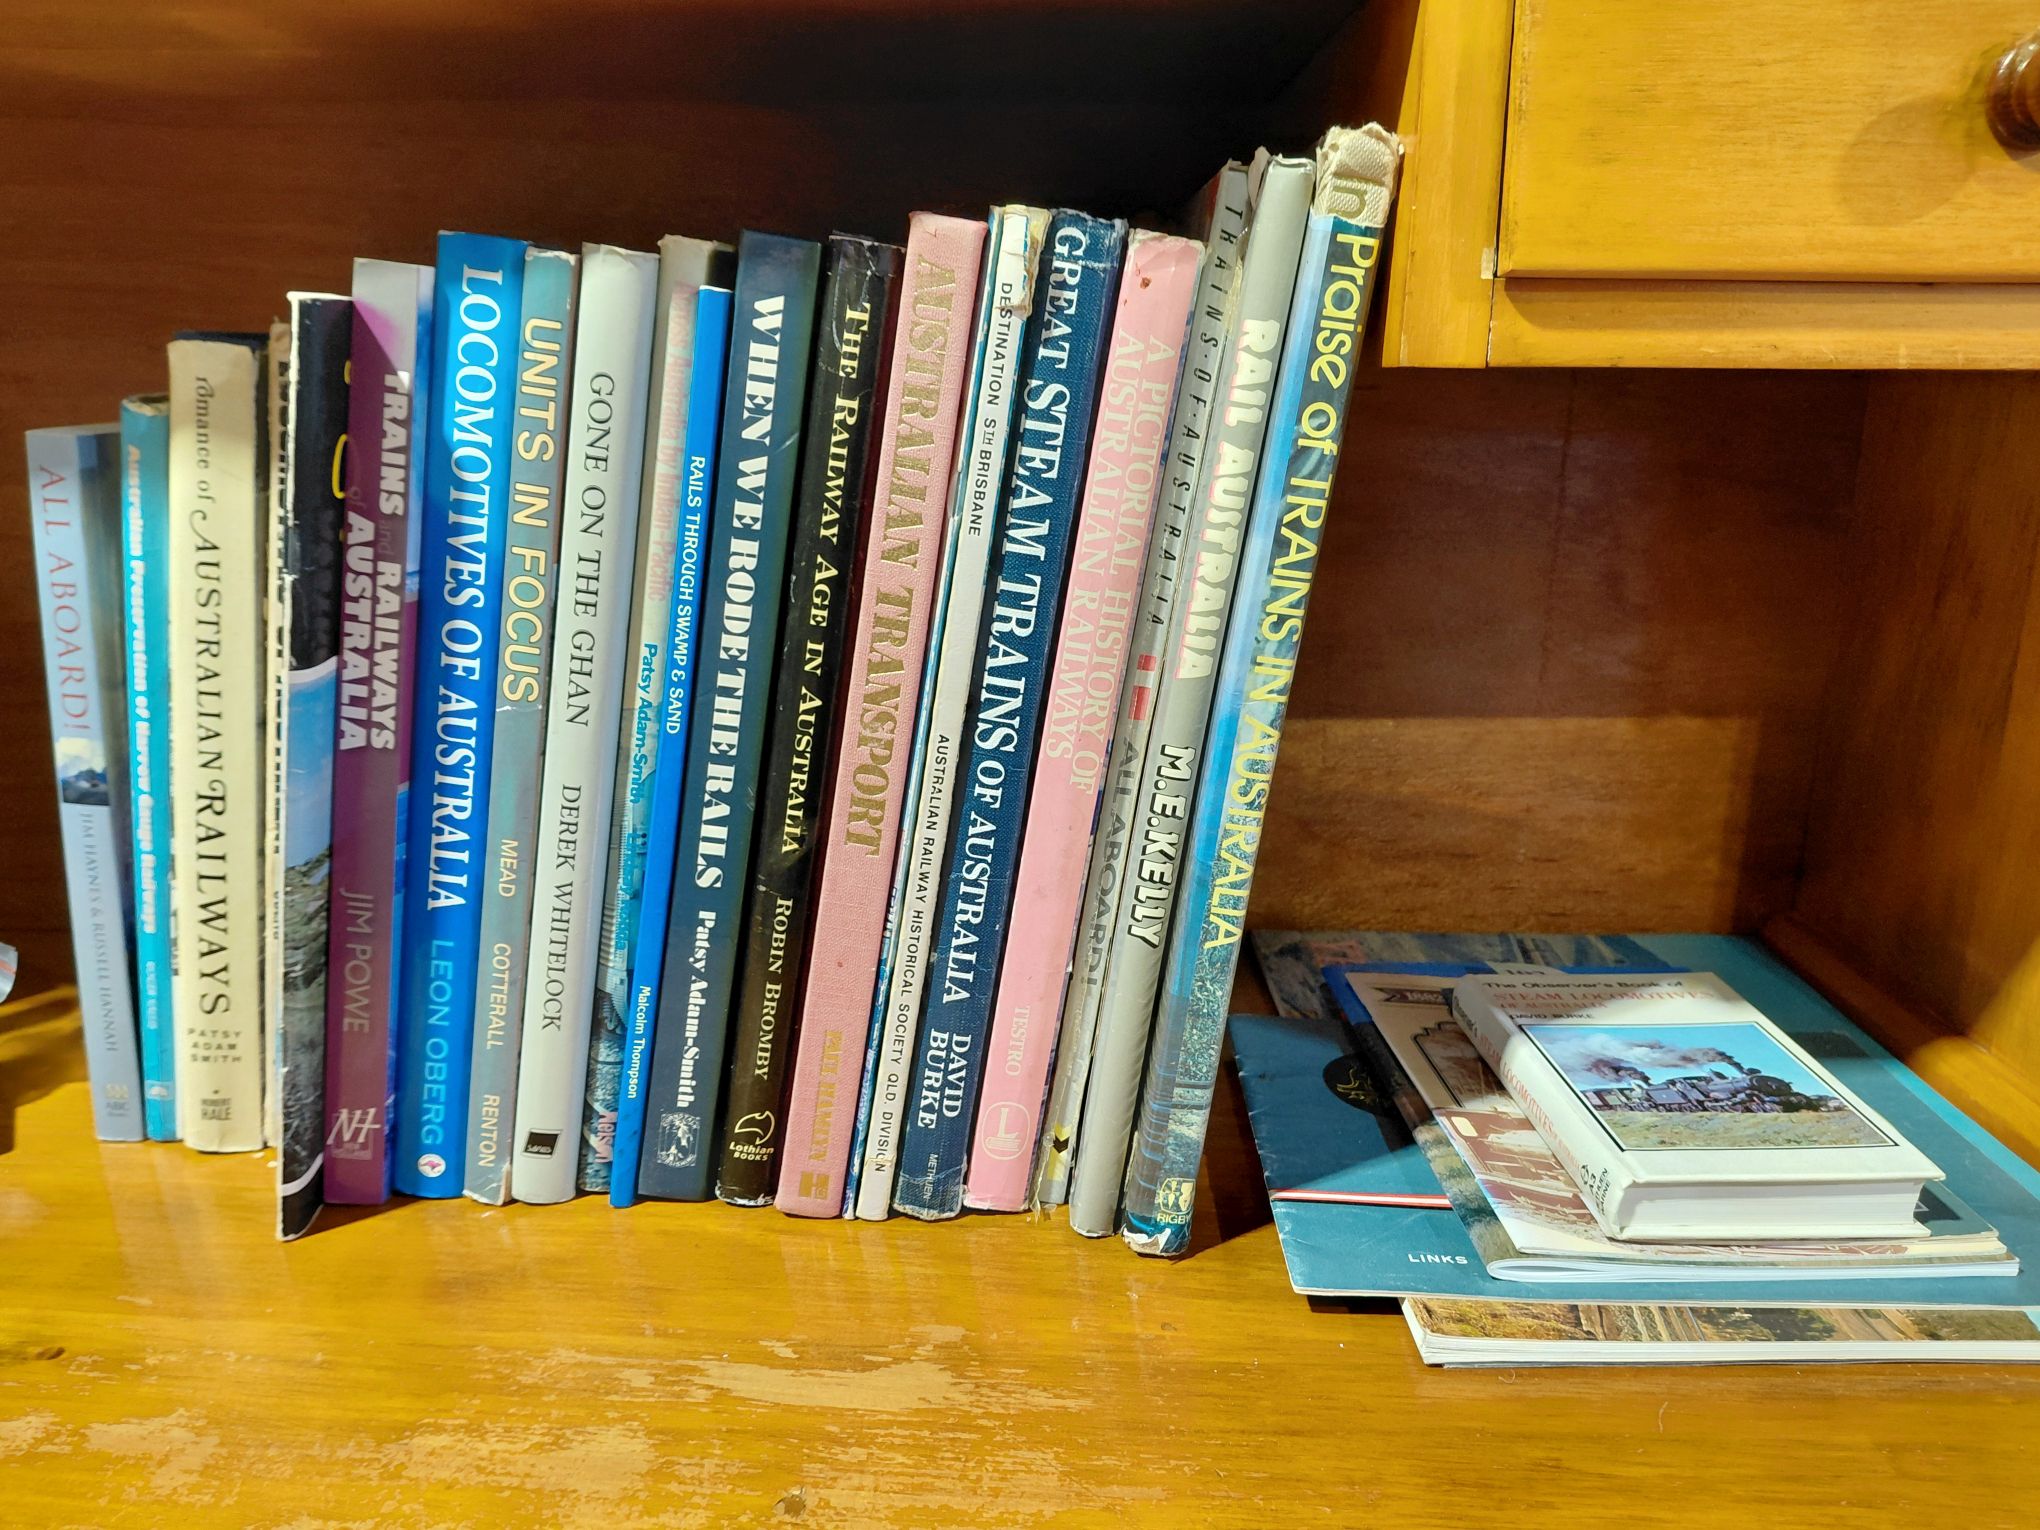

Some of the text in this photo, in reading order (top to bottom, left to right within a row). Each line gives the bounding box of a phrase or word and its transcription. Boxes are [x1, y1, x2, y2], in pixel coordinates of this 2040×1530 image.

[986, 282, 1013, 406] DESTINATION
[1310, 232, 1380, 390] Praise
[379, 372, 411, 517] TRAINS
[659, 354, 692, 440] Australia
[197, 480, 216, 502] of
[655, 443, 685, 468] by
[968, 450, 992, 537] BRISBANE
[1175, 318, 1280, 681] RAIL AUSTRALIA
[501, 317, 563, 703] UNITS IN FOCUS
[566, 371, 616, 728] GONE ON THE GHAN
[844, 254, 956, 857] AUSTRALIAN TRANSPORT
[1046, 329, 1145, 759] AUSTRALIAN RAILWAYS
[1261, 474, 1334, 643] TRAINS
[39, 464, 92, 731] ALL ABOARD!
[427, 263, 503, 912] LOCOMOTIVES OF AUSTRALIA
[666, 455, 705, 735] RAILS THROUGH SWAMP & SAND
[695, 294, 785, 889] WHEN WE RODE THE RAILS
[781, 301, 871, 853] THE RAILWAY AGE IN AUSTRALIA
[1069, 335, 1176, 795] A PICTORIAL HISTORY OF
[189, 509, 224, 772] AUSTRALIAN
[339, 511, 375, 750] AUSTRALIA
[370, 560, 402, 750] RAILWAYS
[942, 226, 1087, 1004] GREAT STEAM TRAINS OF AUSTRALIA
[128, 444, 157, 933] Australian Preservation of Narrow Gauge Railways
[637, 643, 658, 694] Patsy
[1249, 655, 1293, 703] IN
[925, 734, 950, 831] AUSTRALIAN
[1111, 736, 1140, 804] ALL
[84, 843, 104, 902] HAYNES
[498, 838, 518, 898] MEAD
[914, 836, 935, 904] RAILWAY
[1204, 714, 1282, 948] AUSTRALIA
[196, 779, 232, 1017] RAILWAYS
[541, 784, 582, 1033] DEREK WHITELOCK
[93, 922, 111, 981] RUSSELL
[340, 888, 374, 1033] JIM POWE
[486, 942, 511, 1050] COTTERALL
[754, 897, 794, 1081] ROBIN BROMBY
[900, 909, 926, 997] HISTORICAL
[1482, 981, 1517, 989] The
[1522, 981, 1613, 989] Observer's
[1615, 981, 1661, 989] Book
[1492, 991, 1564, 1001] STEAM
[100, 987, 119, 1053] HANNAH
[187, 1027, 242, 1039] PATSY
[189, 1053, 242, 1063] SMITH
[191, 1041, 237, 1051] ADAM
[421, 939, 455, 1145] LEON OBERG
[627, 985, 651, 1099] Malcolm Thompson
[676, 909, 717, 1108] Patsy Adam-Smith
[891, 1003, 910, 1065] SOCIETY
[1005, 1006, 1031, 1077] TESTRO
[808, 1080, 838, 1163] HAMLYN
[884, 1073, 900, 1105] QLD.
[917, 1028, 949, 1129] BURKE
[942, 1034, 971, 1118] DAVID
[1502, 1062, 1554, 1136] LOCOMOTIVES
[477, 1093, 500, 1169] RENTON
[729, 1141, 775, 1154] Lothian
[733, 1151, 769, 1161] BOOKS
[922, 1153, 939, 1200] METHUEN
[1408, 1253, 1469, 1265] LINKS
